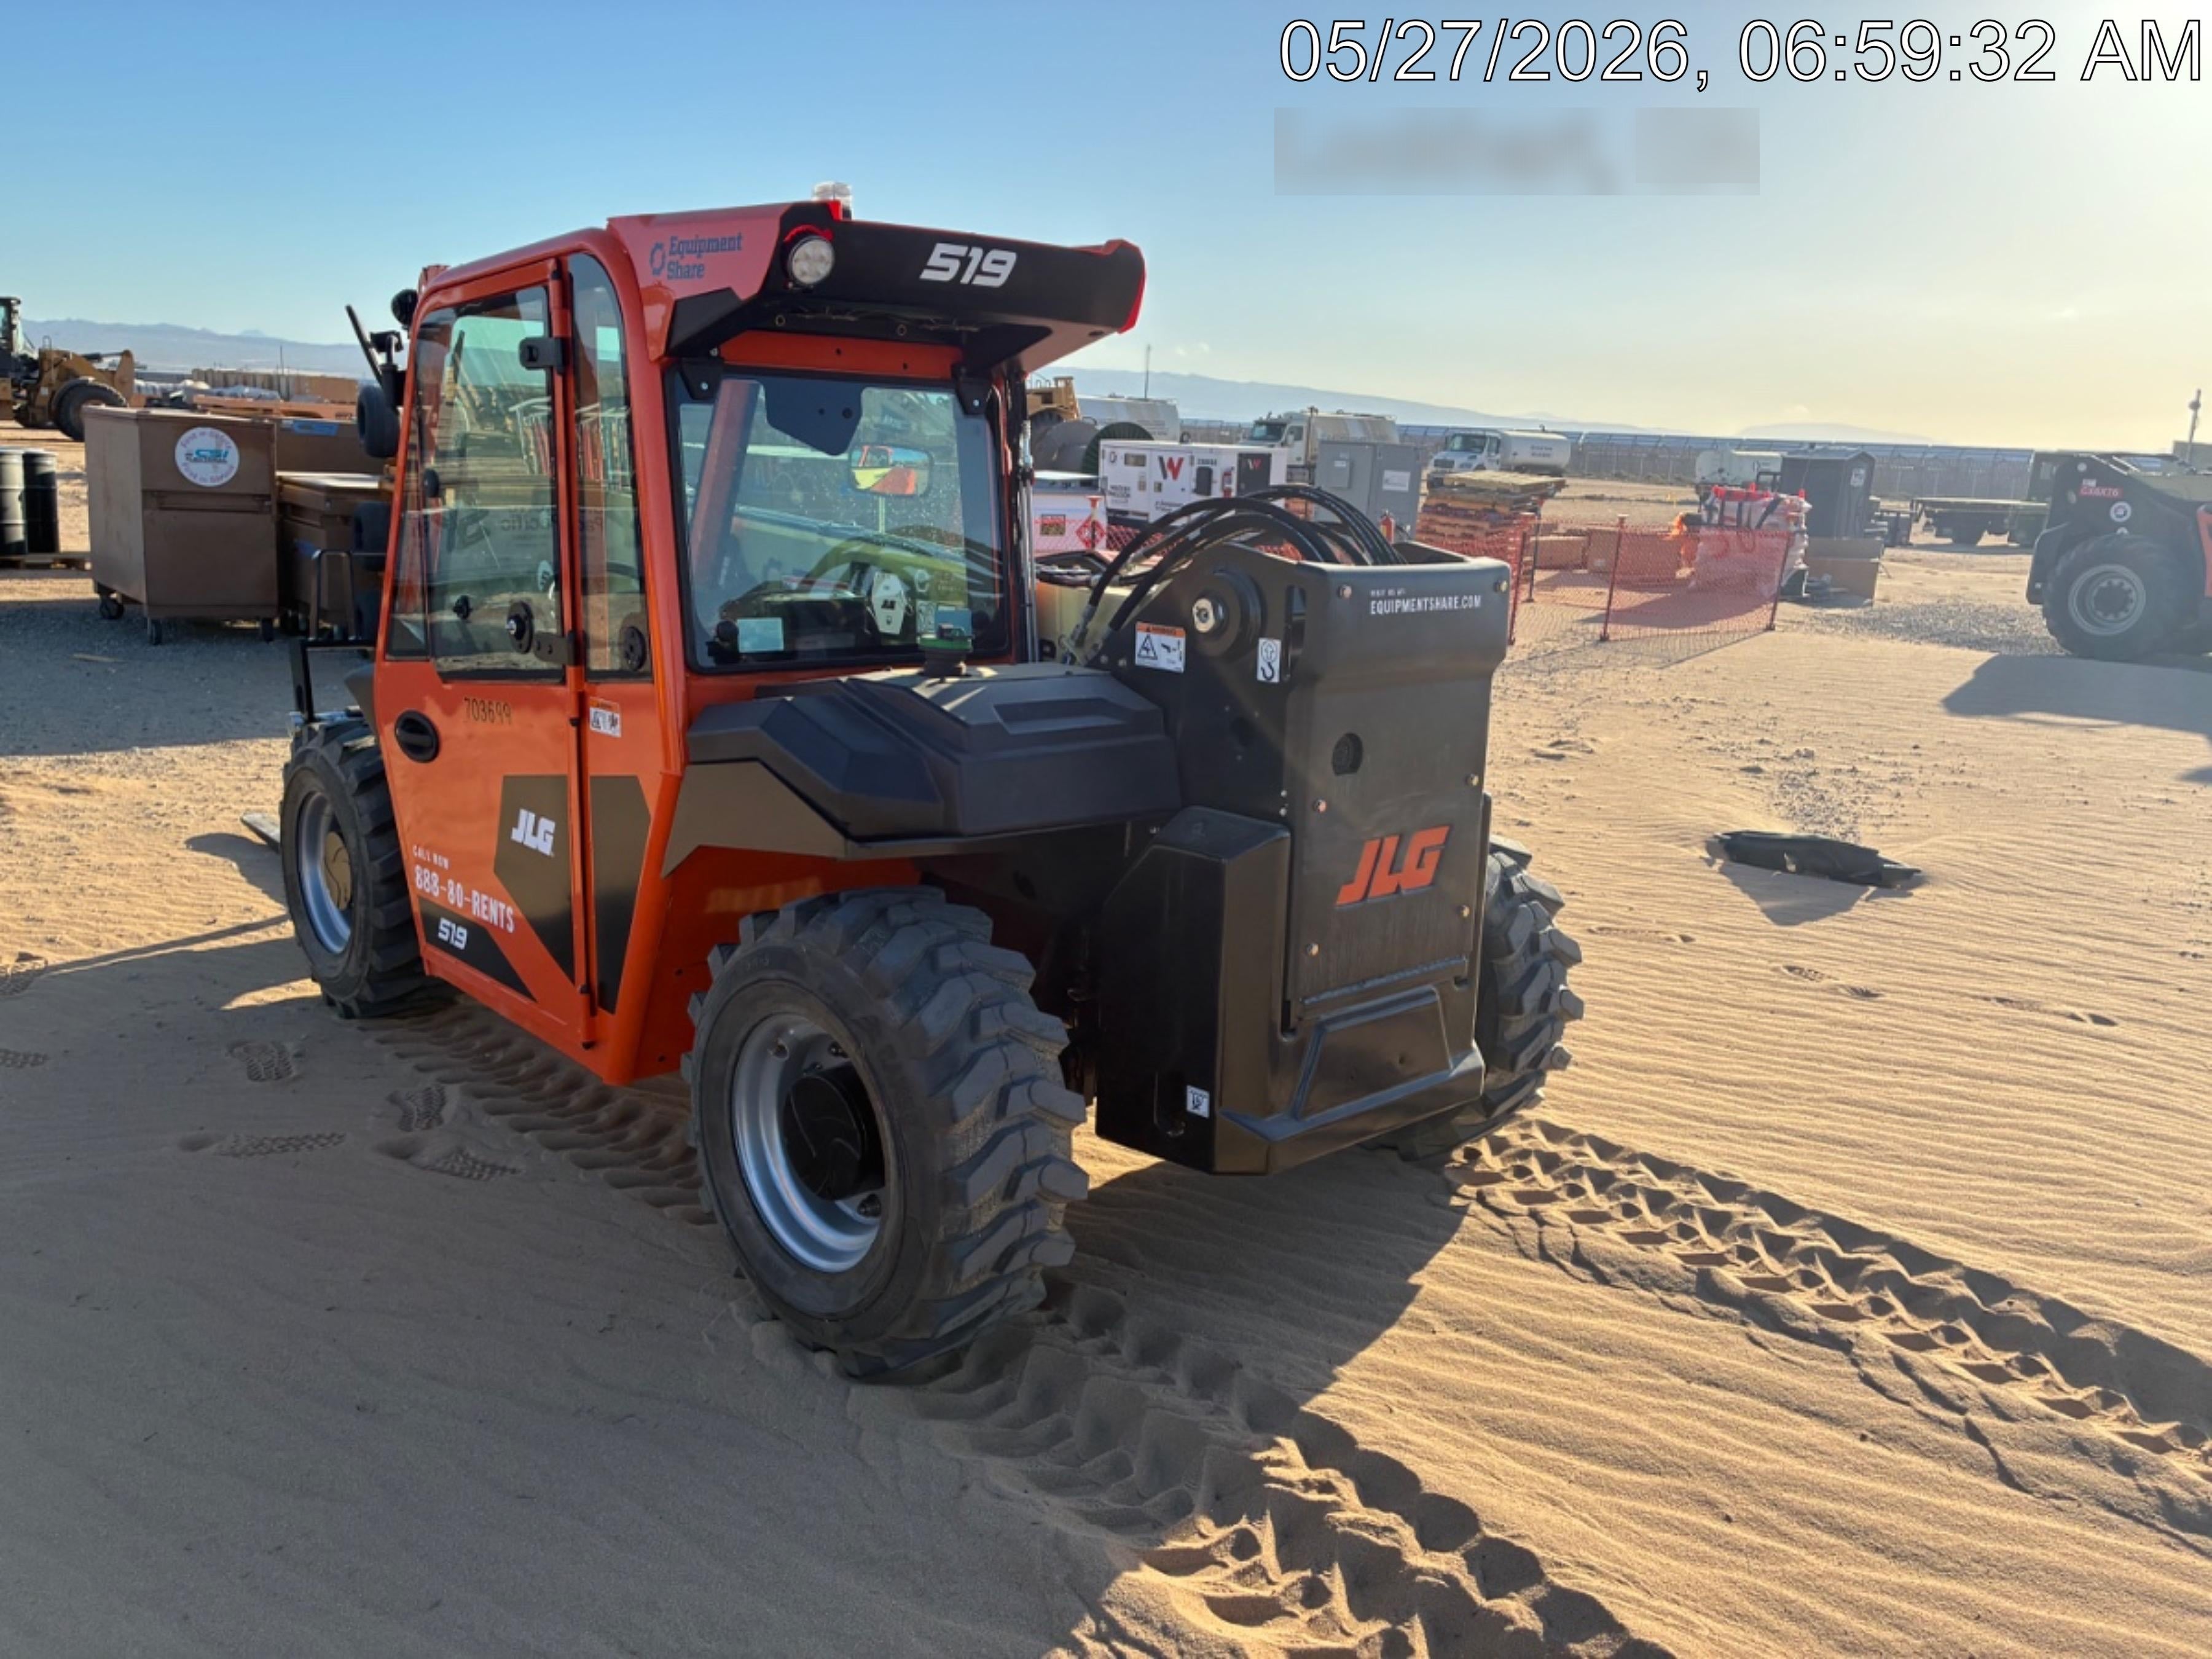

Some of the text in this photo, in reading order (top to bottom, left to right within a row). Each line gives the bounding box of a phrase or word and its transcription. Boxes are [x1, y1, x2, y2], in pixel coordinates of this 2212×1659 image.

[669, 232, 742, 259] Equipment
[667, 261, 705, 280] Share
[919, 243, 1017, 288] 519
[1370, 594, 1481, 615] EQUIPMENTSHARE.COM
[464, 696, 512, 725] 703699
[511, 809, 555, 856] JLG
[1335, 825, 1451, 906] JLG
[414, 865, 515, 933] 888-80-RENTS
[437, 917, 468, 950] 519
